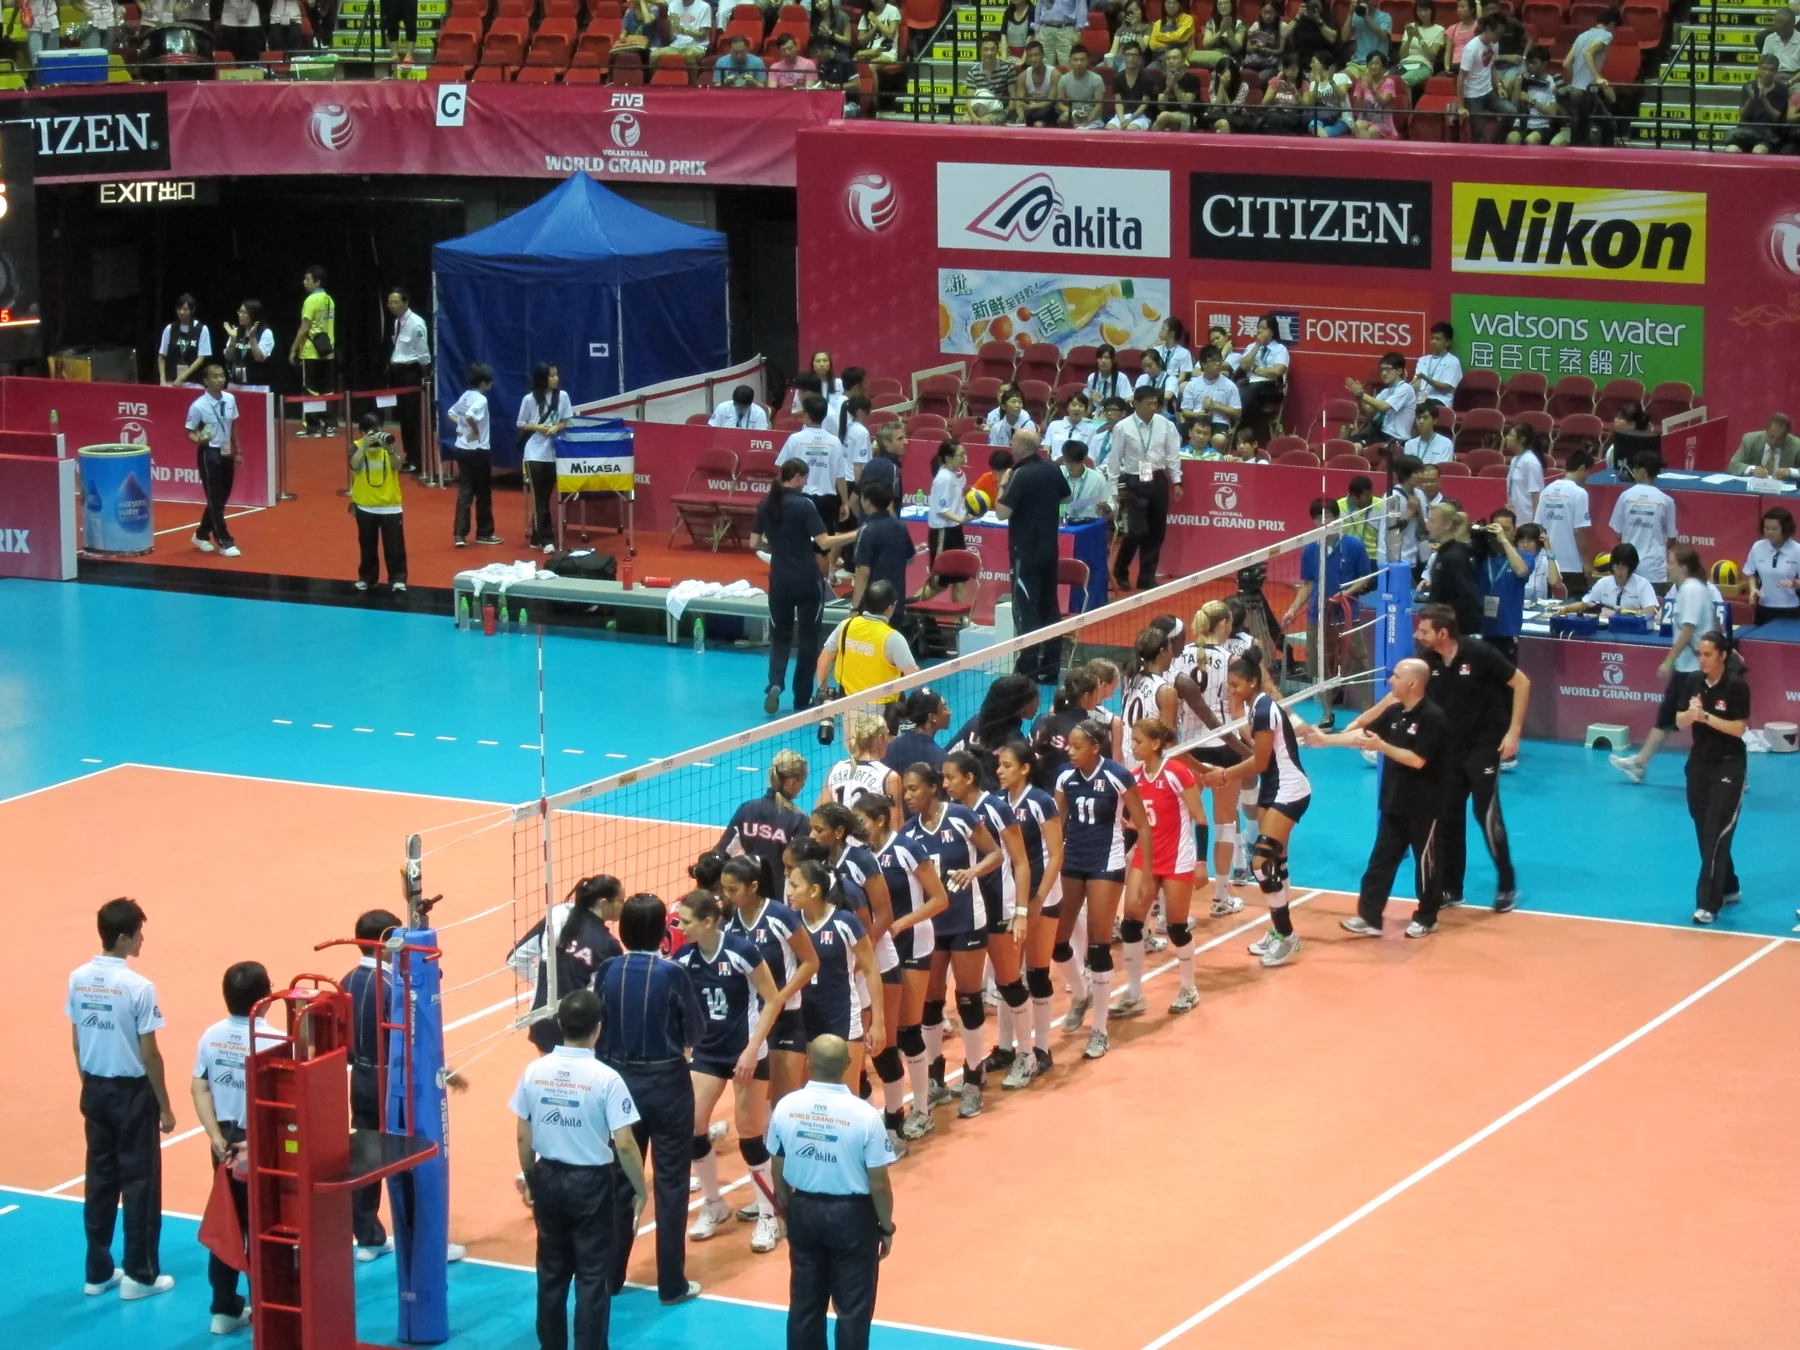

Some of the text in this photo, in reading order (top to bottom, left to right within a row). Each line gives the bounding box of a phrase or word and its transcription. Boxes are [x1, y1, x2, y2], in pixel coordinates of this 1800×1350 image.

[441, 92, 460, 118] C
[611, 93, 644, 107] FIVB
[0, 113, 150, 155] IZEN
[602, 149, 649, 157] VOLLEYBALL
[545, 156, 707, 176] WORLD GRAND PRIX
[100, 182, 157, 203] EXIT
[158, 181, 195, 201] 出口
[1053, 205, 1142, 250] akita
[1202, 194, 1412, 244] CITIZEN
[1464, 198, 1692, 271] Nikon
[1306, 318, 1411, 346] FORTRESS
[118, 402, 148, 416] FIVB
[750, 439, 772, 450] FIVB
[174, 467, 203, 484] PRI
[634, 473, 650, 484] RIX
[1214, 472, 1238, 483] FIVB
[1166, 513, 1285, 531] WORLD GRAND PRIX
[0, 528, 30, 554] IX
[964, 535, 982, 543] FIVB
[1692, 536, 1715, 546] PRIX
[994, 571, 1011, 580] PRI
[845, 639, 875, 656] FIVB
[1181, 653, 1222, 670] TAS
[1601, 652, 1623, 662] FIVB
[1560, 686, 1666, 703] WORLD GRAND PRI
[1075, 796, 1095, 824] 11
[1143, 799, 1156, 826] 5
[743, 822, 788, 843] USA
[97, 1020, 115, 1030] akita
[556, 1081, 576, 1089] GRAND
[560, 1117, 582, 1128] akita
[789, 1112, 811, 1120] WORLD
[812, 1115, 834, 1123] GRAND
[835, 1118, 851, 1127] PRIX
[813, 1122, 825, 1130] Kong
[815, 1151, 837, 1163] akita
